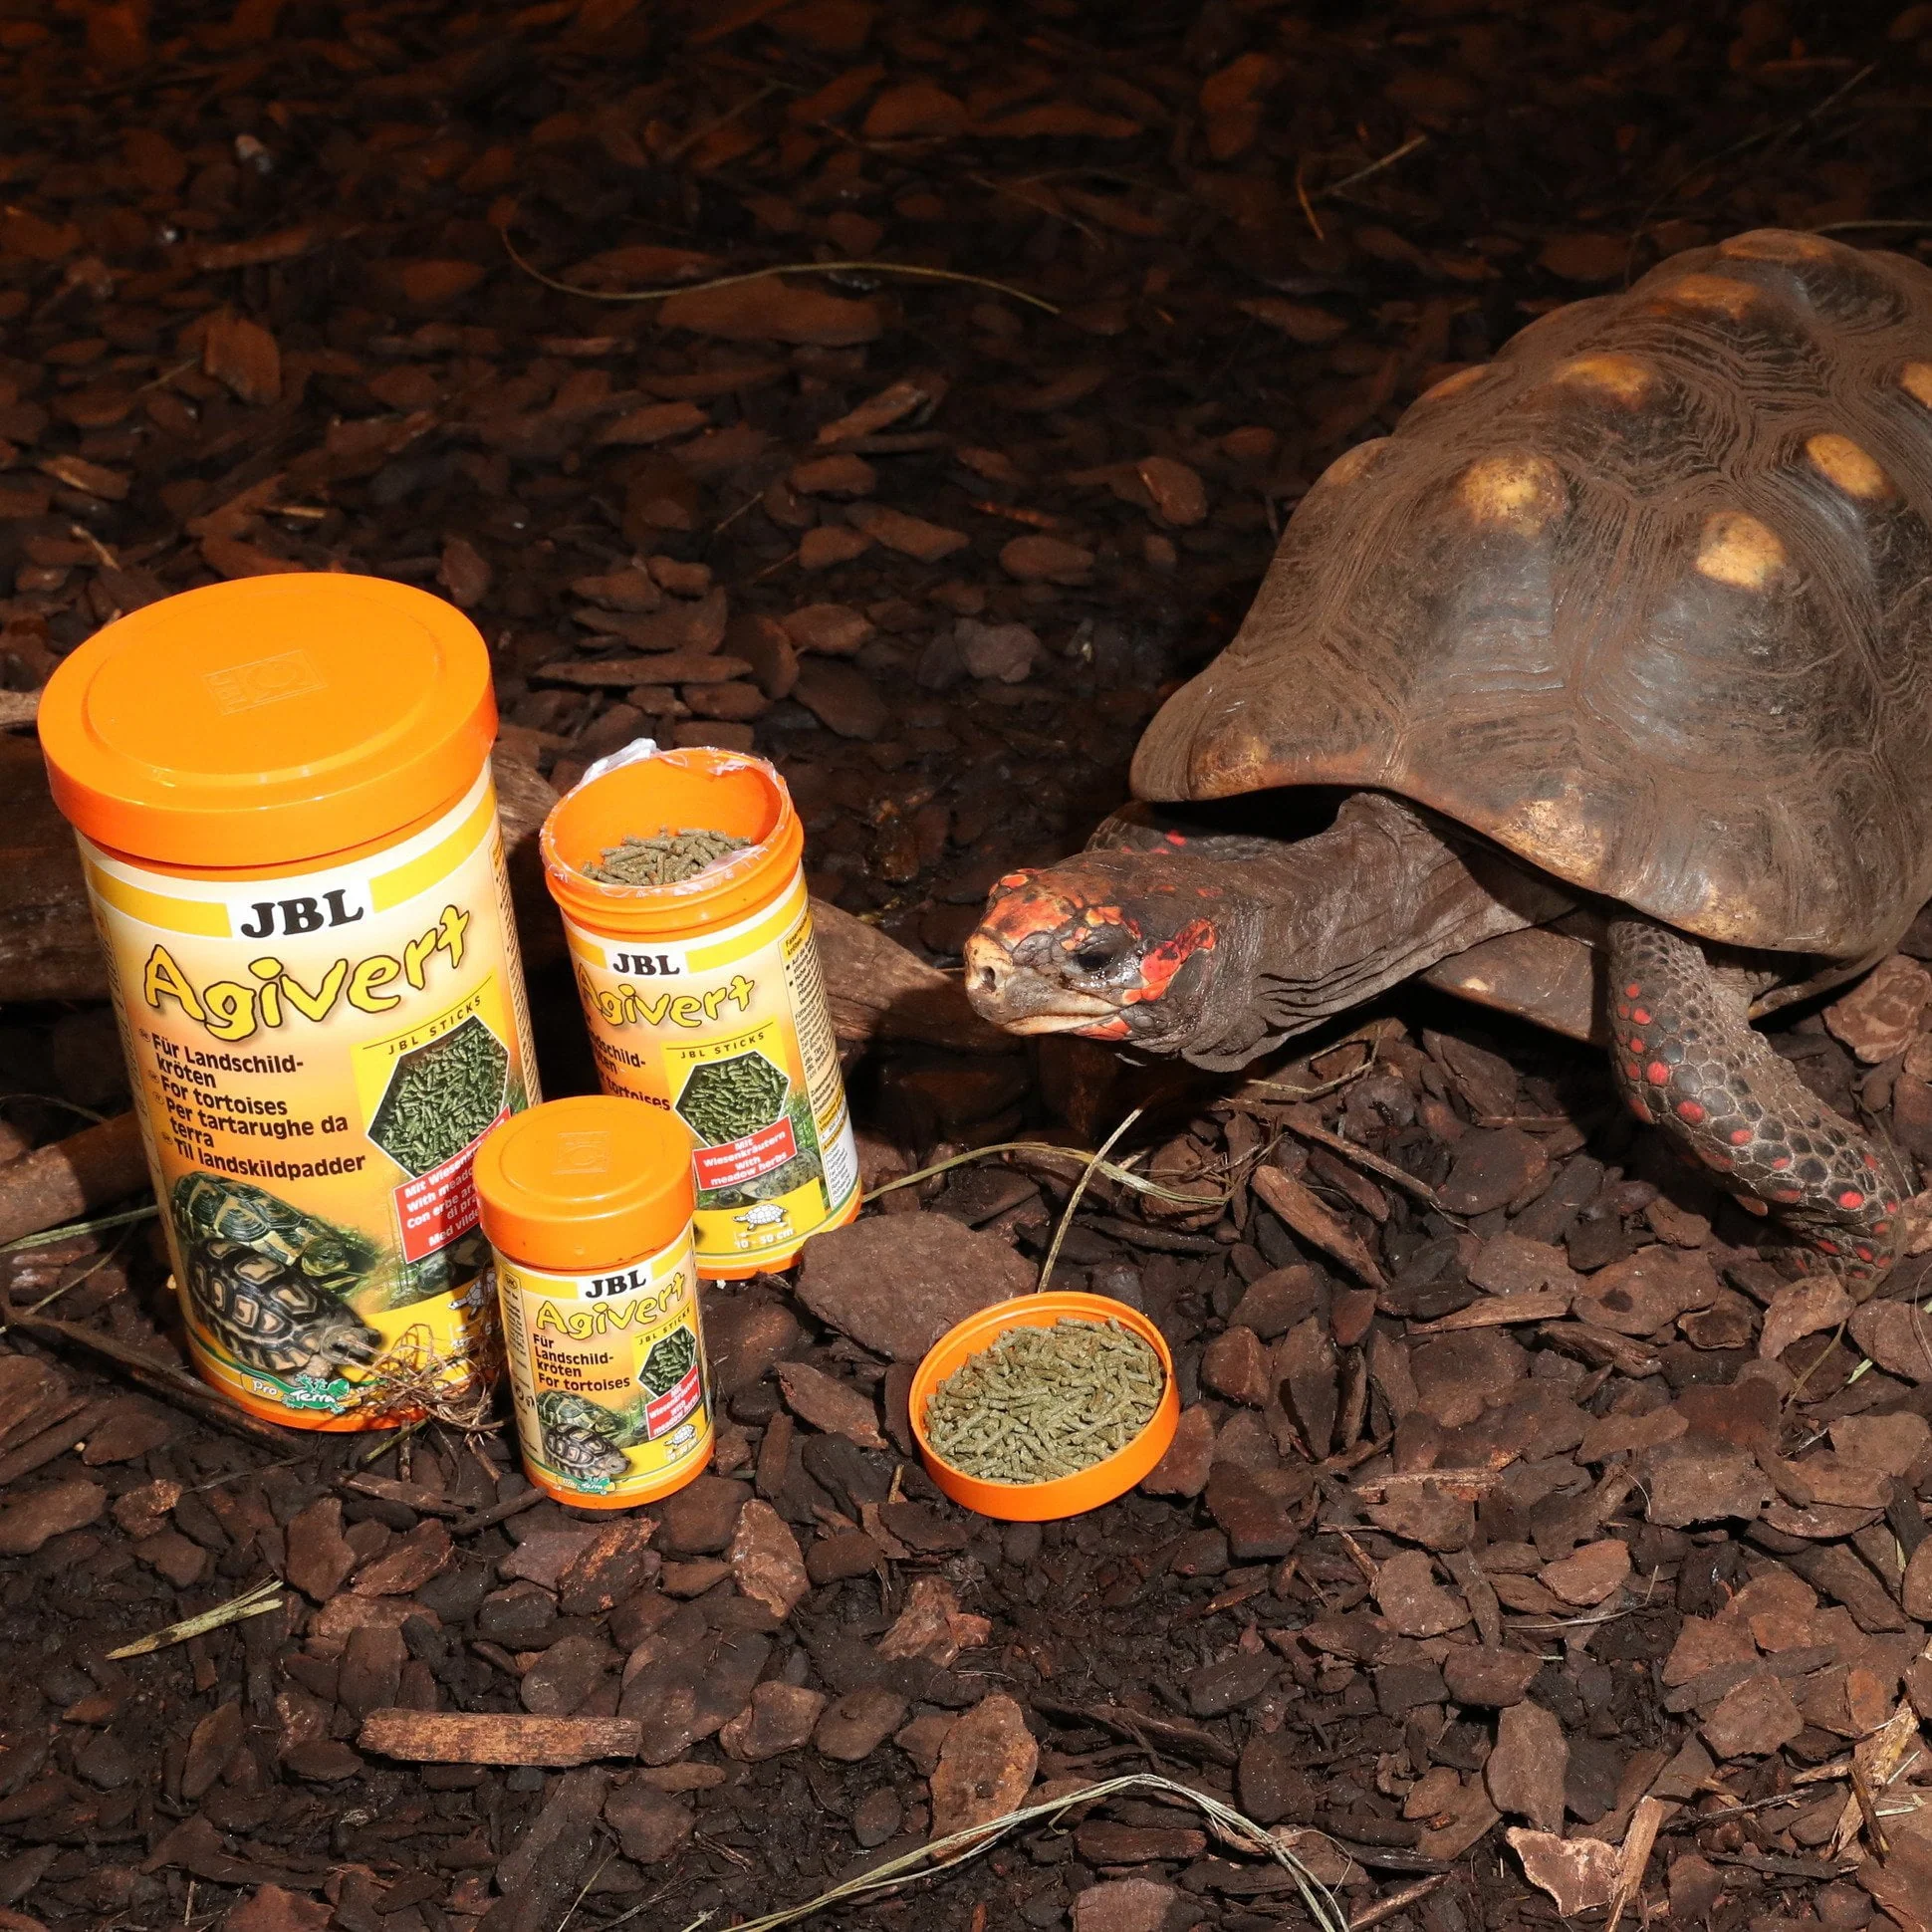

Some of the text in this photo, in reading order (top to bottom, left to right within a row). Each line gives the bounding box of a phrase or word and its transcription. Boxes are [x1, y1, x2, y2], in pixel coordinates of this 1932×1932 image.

[241, 888, 363, 938] JBL
[143, 904, 470, 1042] Agivert
[612, 953, 680, 975] JBL
[578, 963, 755, 1028] Agivert
[388, 995, 481, 1055] JBL STICKS
[151, 1032, 180, 1059] Für
[184, 1046, 304, 1074] Landschild-
[680, 1032, 765, 1060] JBL STICKS
[156, 1053, 217, 1088] kröten
[161, 1076, 189, 1101] For
[193, 1087, 287, 1116] tortoises
[166, 1096, 193, 1122] Per
[197, 1108, 315, 1140] tartarughe
[321, 1114, 349, 1134] da
[170, 1115, 214, 1148] terra
[173, 1137, 194, 1160] Til
[198, 1147, 366, 1181] landskildpadder
[734, 1137, 754, 1150] Mit
[438, 1167, 474, 1195] meado
[710, 1151, 787, 1186] meadow herbs
[404, 1180, 426, 1198] Mit
[428, 1225, 454, 1247] Med
[777, 1228, 794, 1240] cm
[586, 1269, 646, 1299] JBL
[536, 1272, 686, 1340] Agivert
[533, 1333, 554, 1349] Für
[639, 1307, 690, 1344] JBL STICKS
[535, 1345, 613, 1365] Landschild-
[537, 1359, 582, 1377] kröten
[253, 1379, 337, 1404] Pro Terra
[539, 1373, 630, 1392] For tortoises
